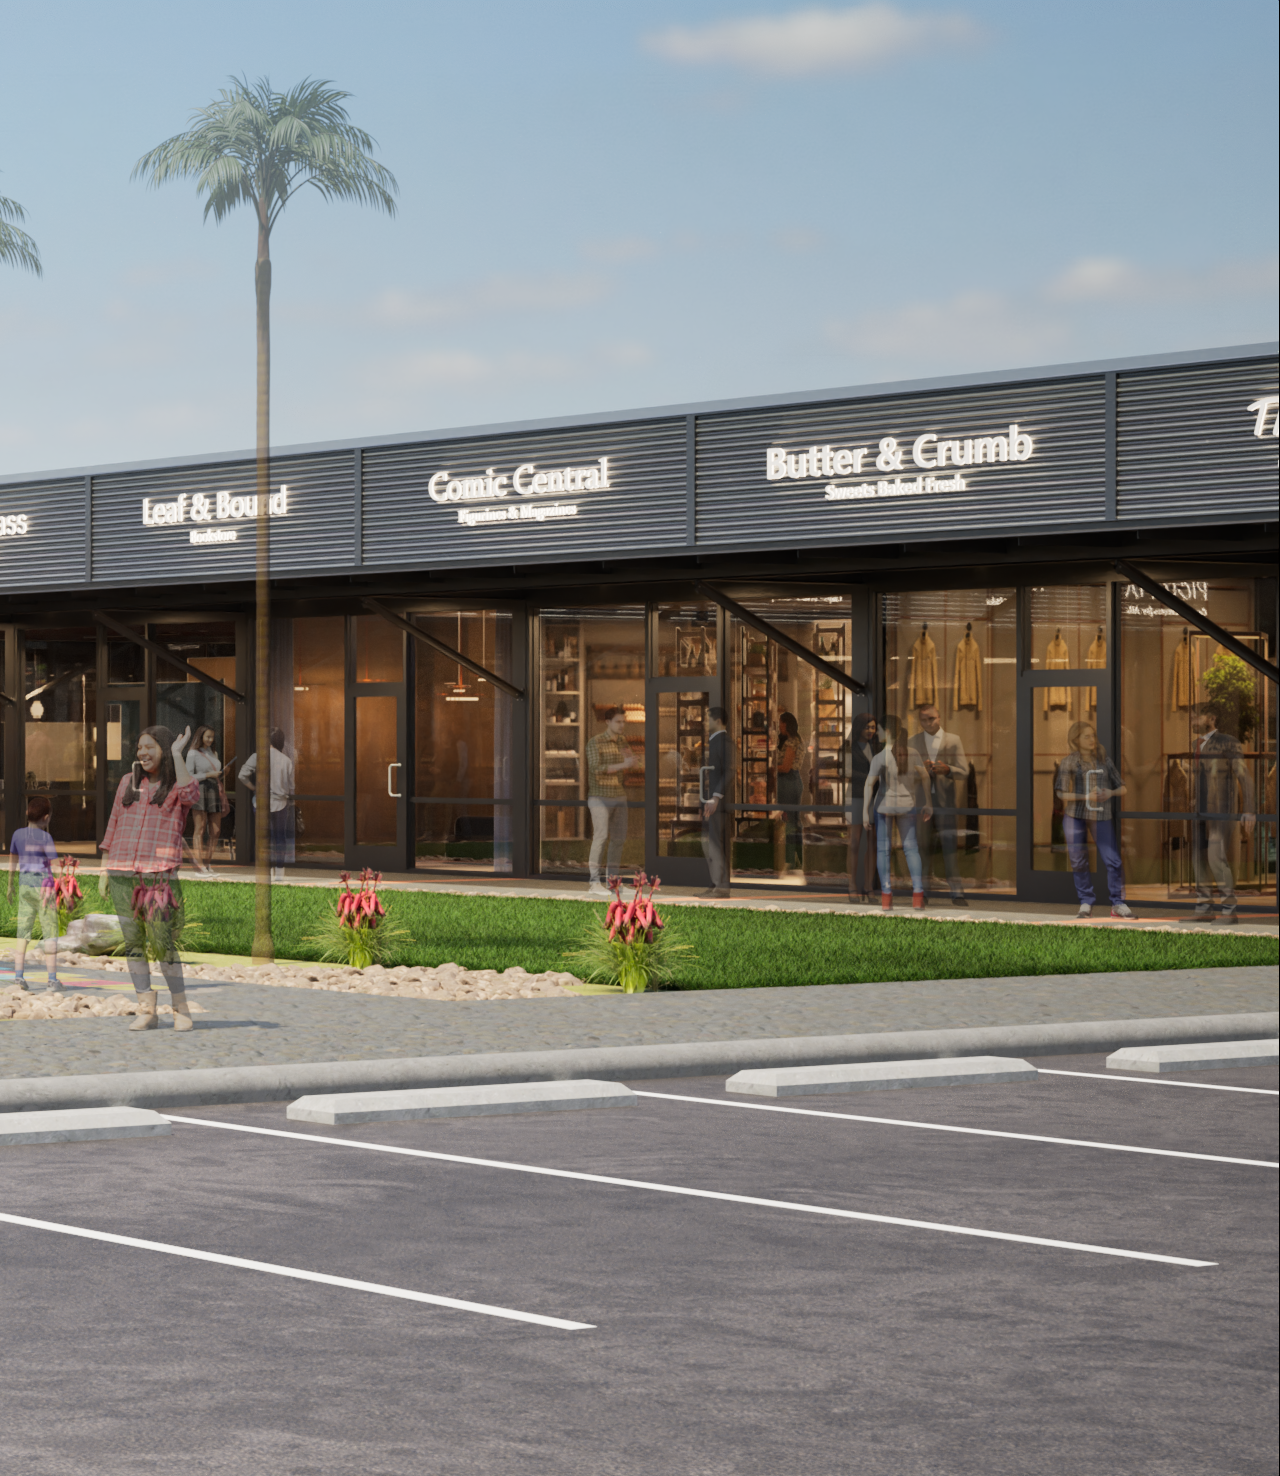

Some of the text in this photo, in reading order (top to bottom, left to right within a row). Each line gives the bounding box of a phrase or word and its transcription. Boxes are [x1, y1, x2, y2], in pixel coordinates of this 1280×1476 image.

[766, 424, 1033, 480] Butter & Crumb
[428, 456, 610, 502] Comic Central
[824, 474, 966, 501] Sweets Baked Fresh
[142, 484, 288, 525] Leaf & Bound
[457, 502, 578, 526] Figurines & Magazines
[189, 528, 238, 544] Bookstore
